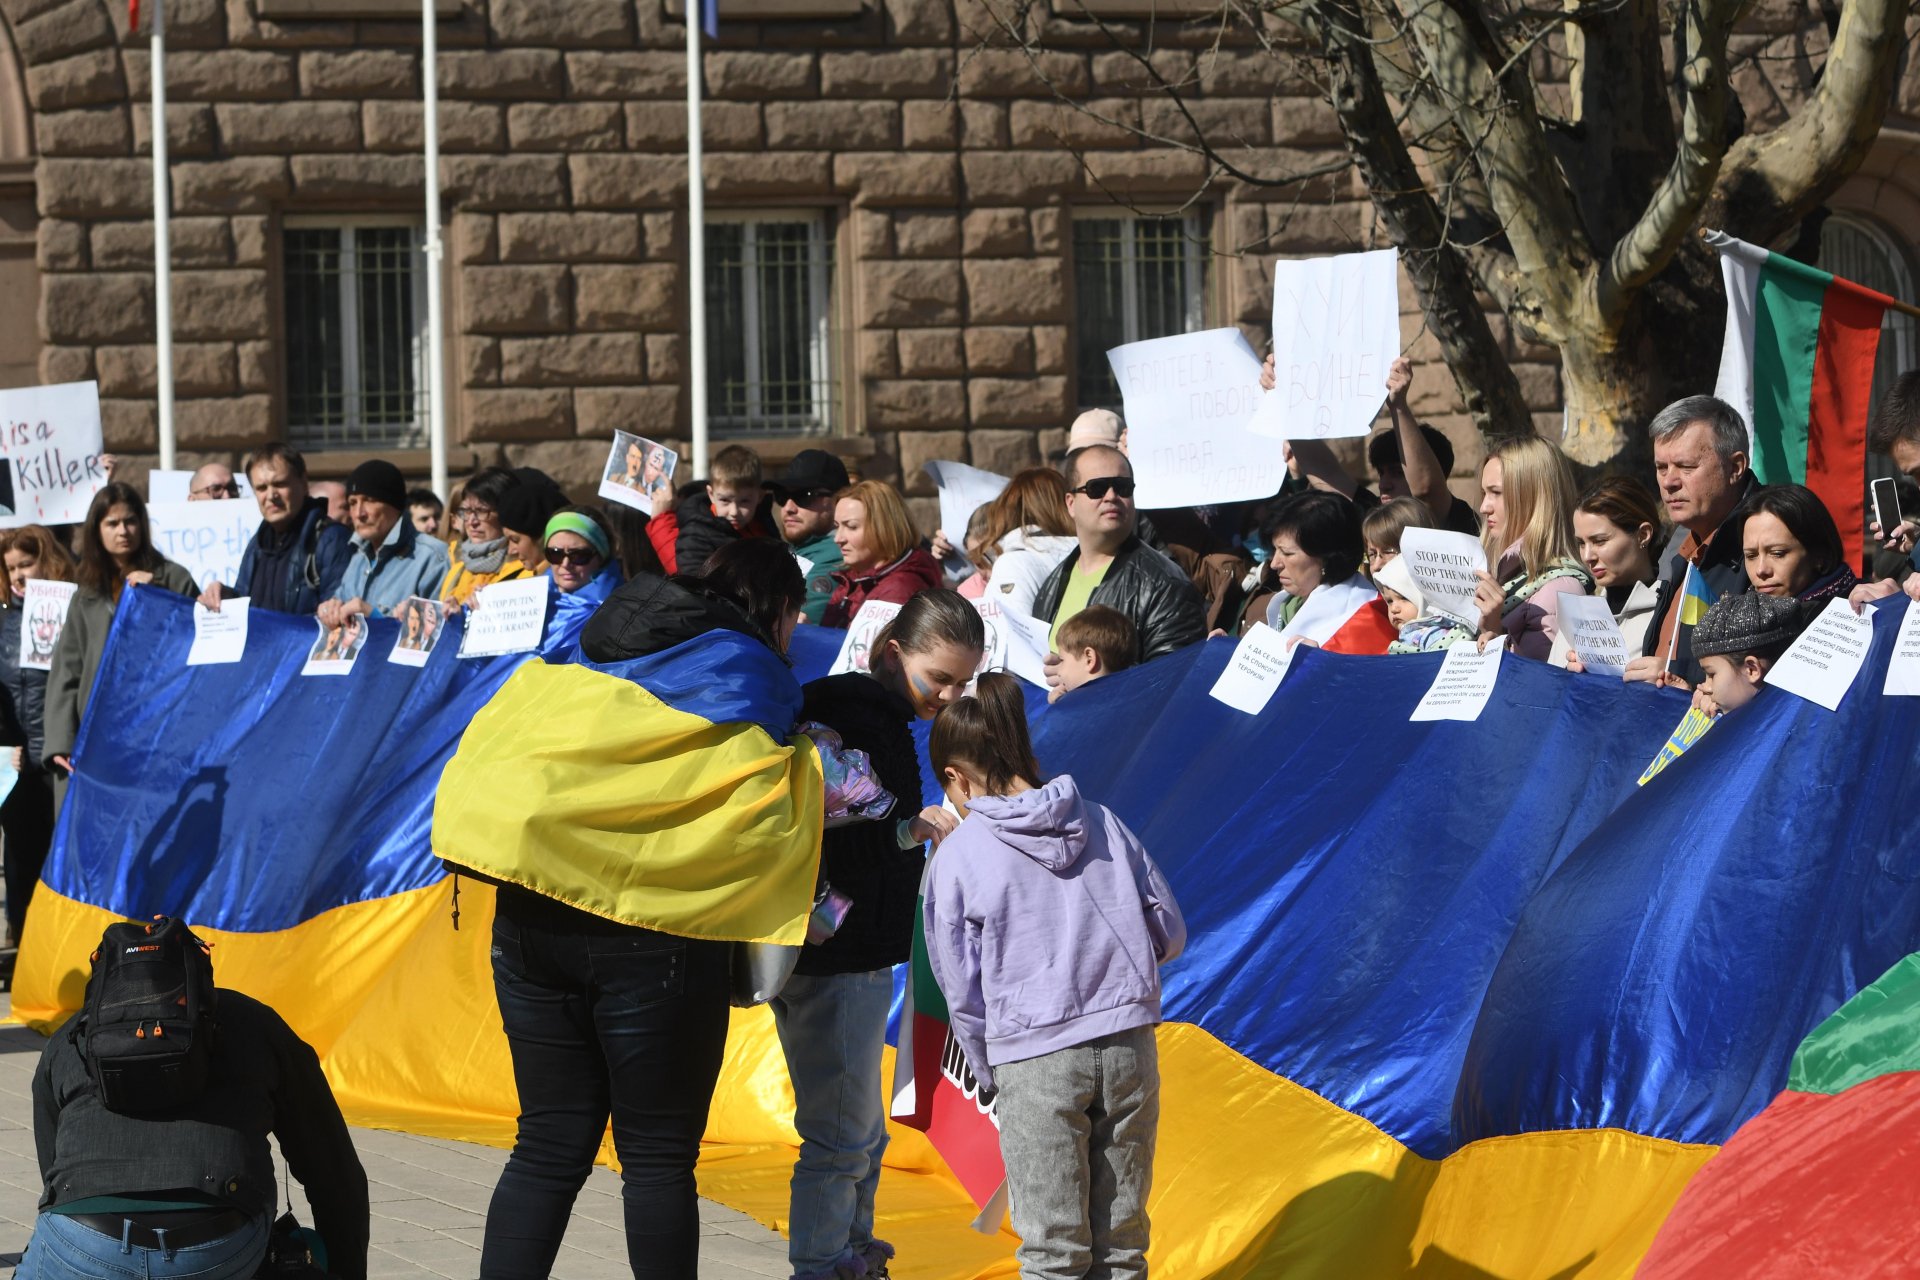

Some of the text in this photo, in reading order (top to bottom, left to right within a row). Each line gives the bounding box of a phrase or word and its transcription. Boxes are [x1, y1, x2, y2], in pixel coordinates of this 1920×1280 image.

[1189, 384, 1260, 421] ПОБОРЕ
[10, 420, 30, 446] is
[1152, 439, 1214, 478] СЛАВА
[223, 515, 256, 556] th
[1415, 550, 1473, 568] STOP PUTIN!
[1413, 565, 1438, 578] STOP
[1438, 568, 1458, 581] THE
[1420, 579, 1476, 598] SAVE UKRAIN
[1584, 619, 1611, 631] PUTIN!
[1585, 635, 1601, 648] THE
[1599, 636, 1622, 648] WAR!
[1253, 647, 1262, 655] ДА
[1591, 653, 1627, 666] UKRAINE!
[125, 945, 161, 954] AVIWEST
